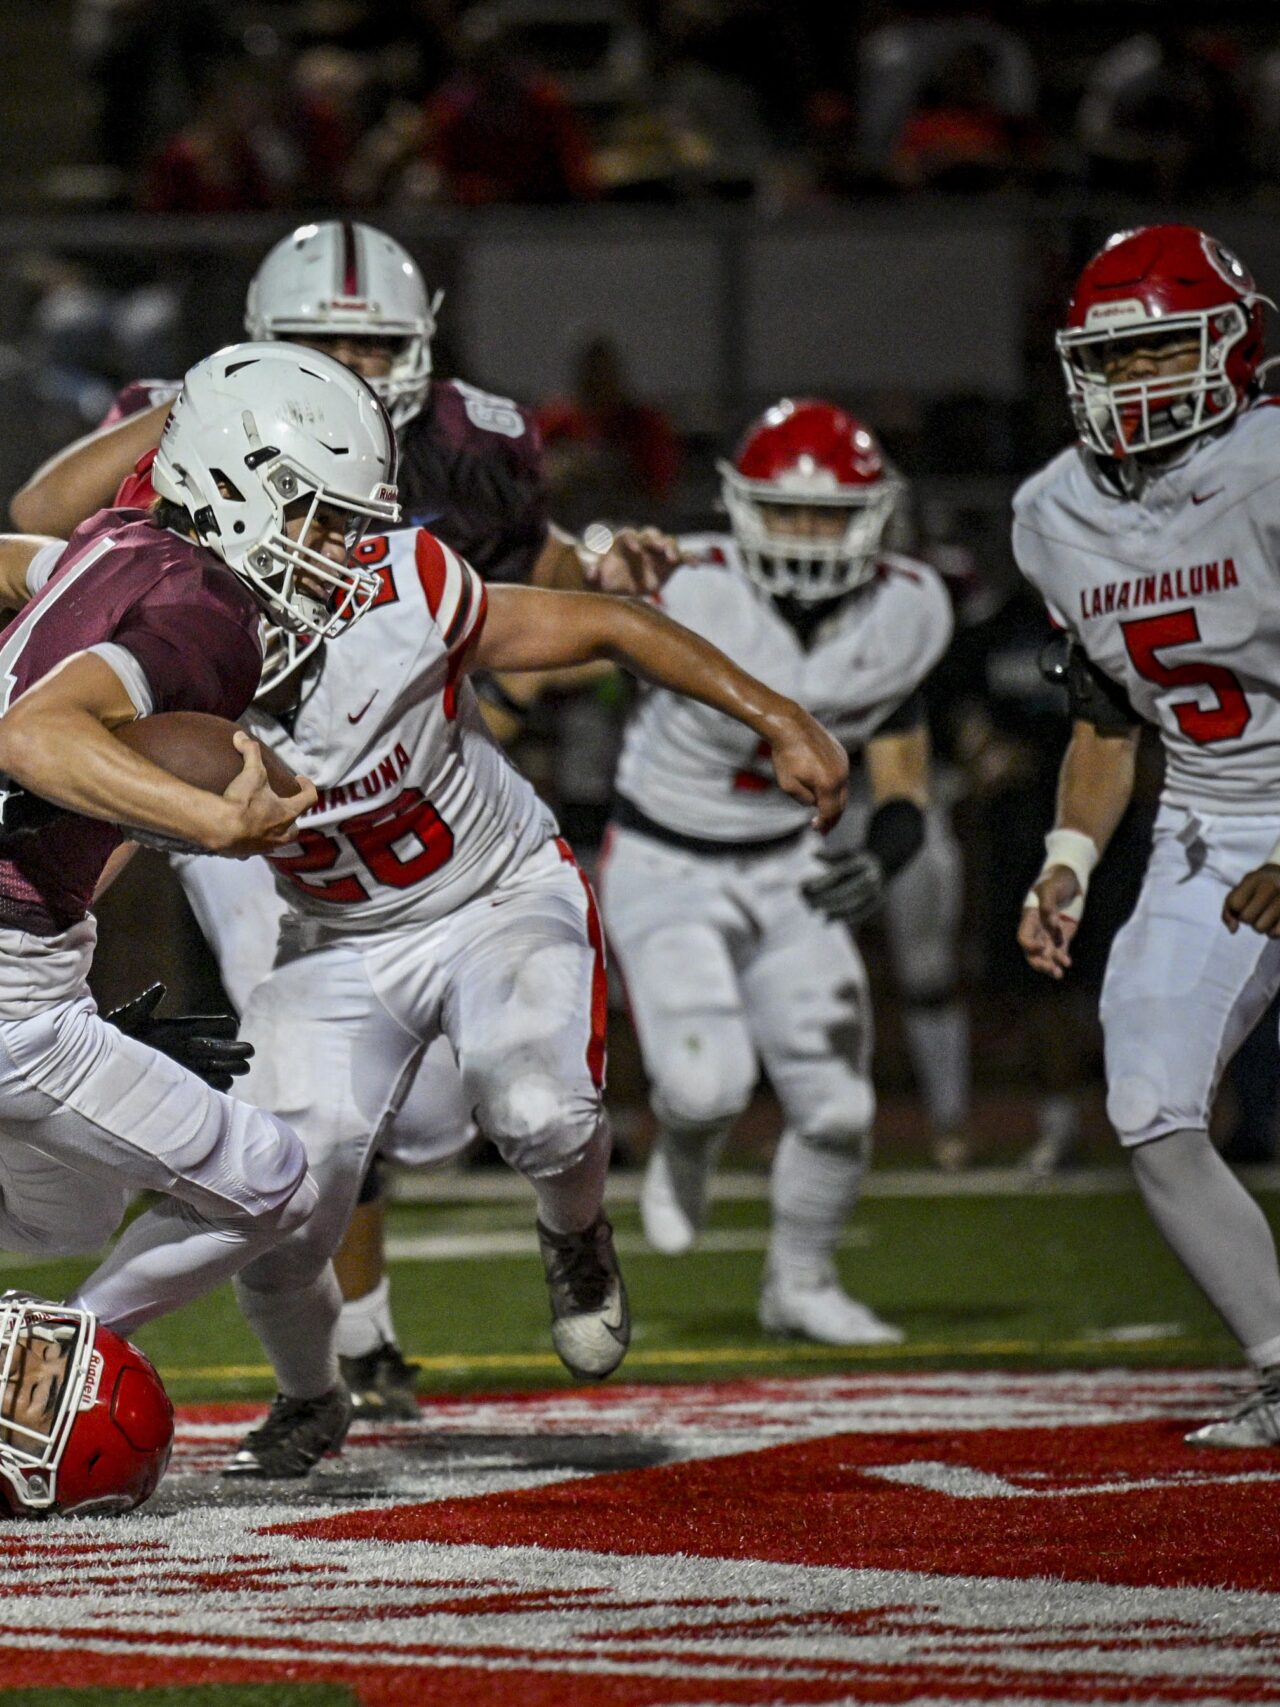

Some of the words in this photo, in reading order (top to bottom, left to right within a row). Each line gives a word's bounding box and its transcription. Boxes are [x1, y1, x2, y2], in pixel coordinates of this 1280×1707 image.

[1081, 557, 1239, 620] LAHAINALUNA
[1120, 607, 1252, 746] 5
[300, 741, 410, 818] NALUNA
[81, 1354, 100, 1404] Riddell
